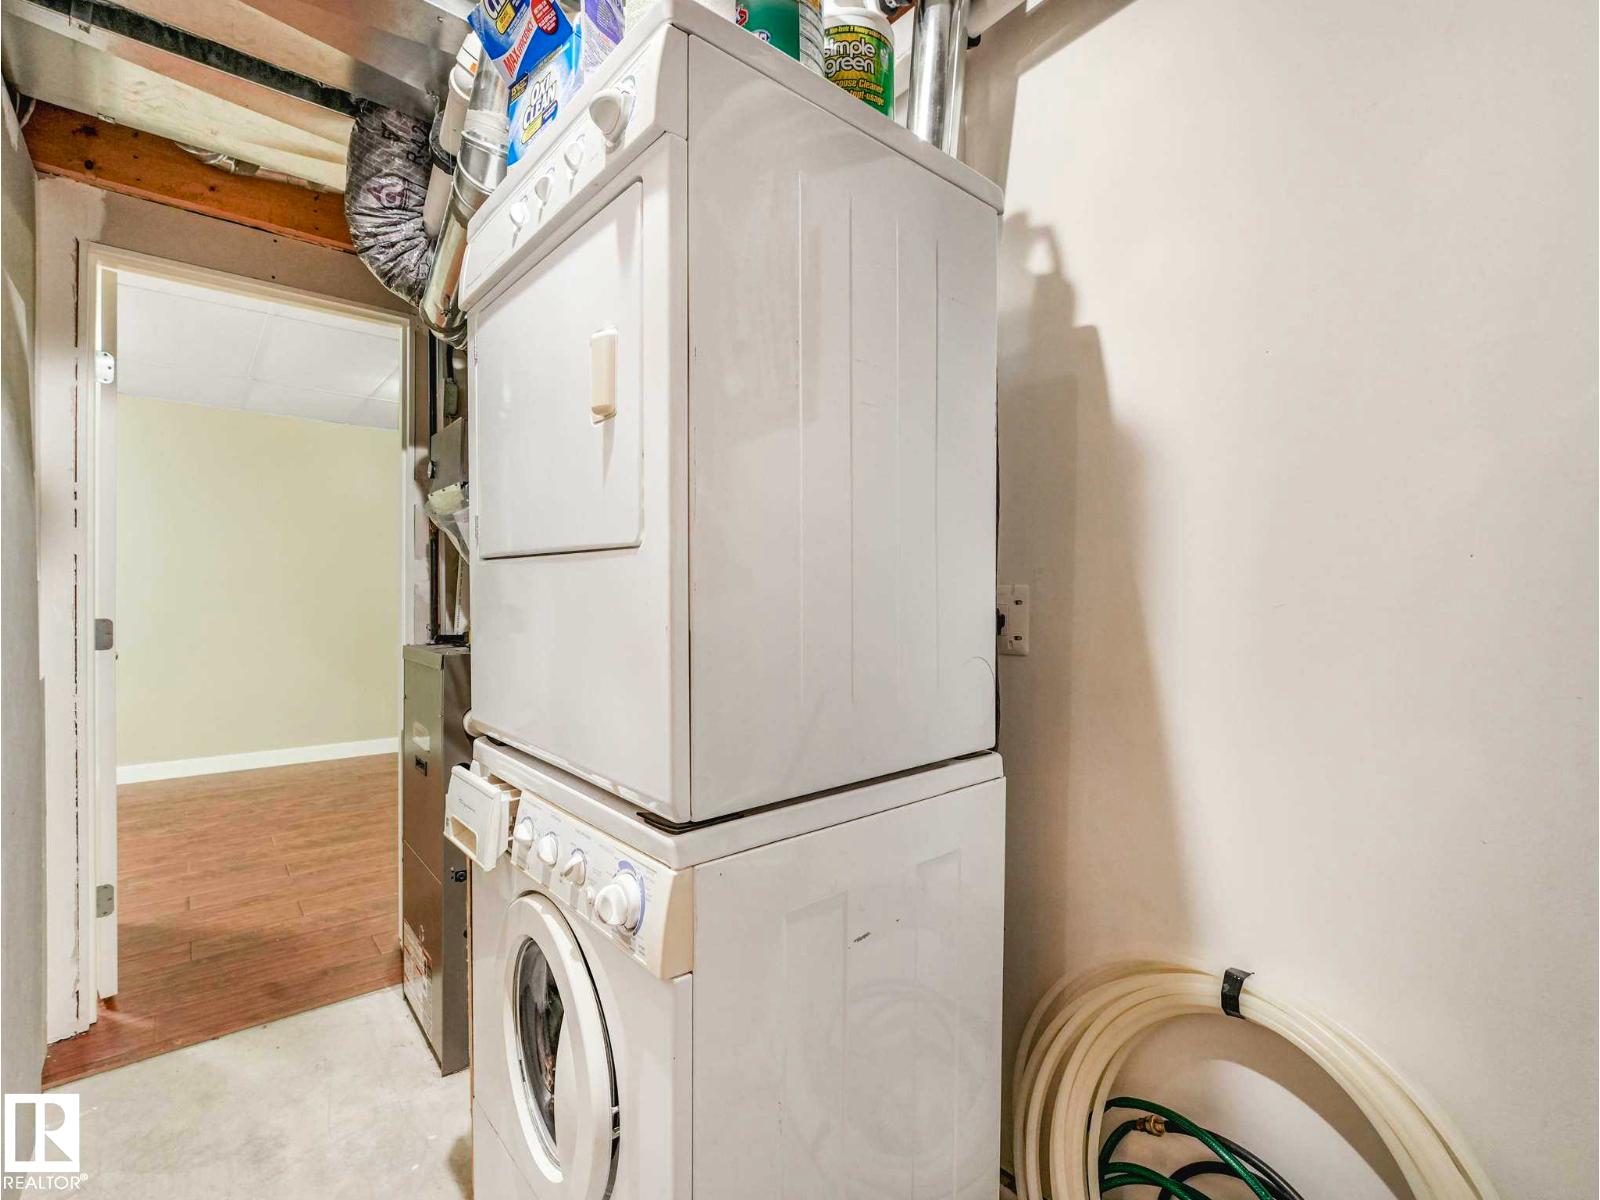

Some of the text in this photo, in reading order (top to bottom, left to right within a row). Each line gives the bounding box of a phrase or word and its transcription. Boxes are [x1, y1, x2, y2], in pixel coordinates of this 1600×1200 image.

[823, 37, 875, 59] simple
[503, 47, 520, 78] MAX
[824, 56, 875, 78] green
[530, 72, 552, 106] OXI
[859, 79, 884, 93] Cleaner
[523, 80, 557, 130] CLEAN
